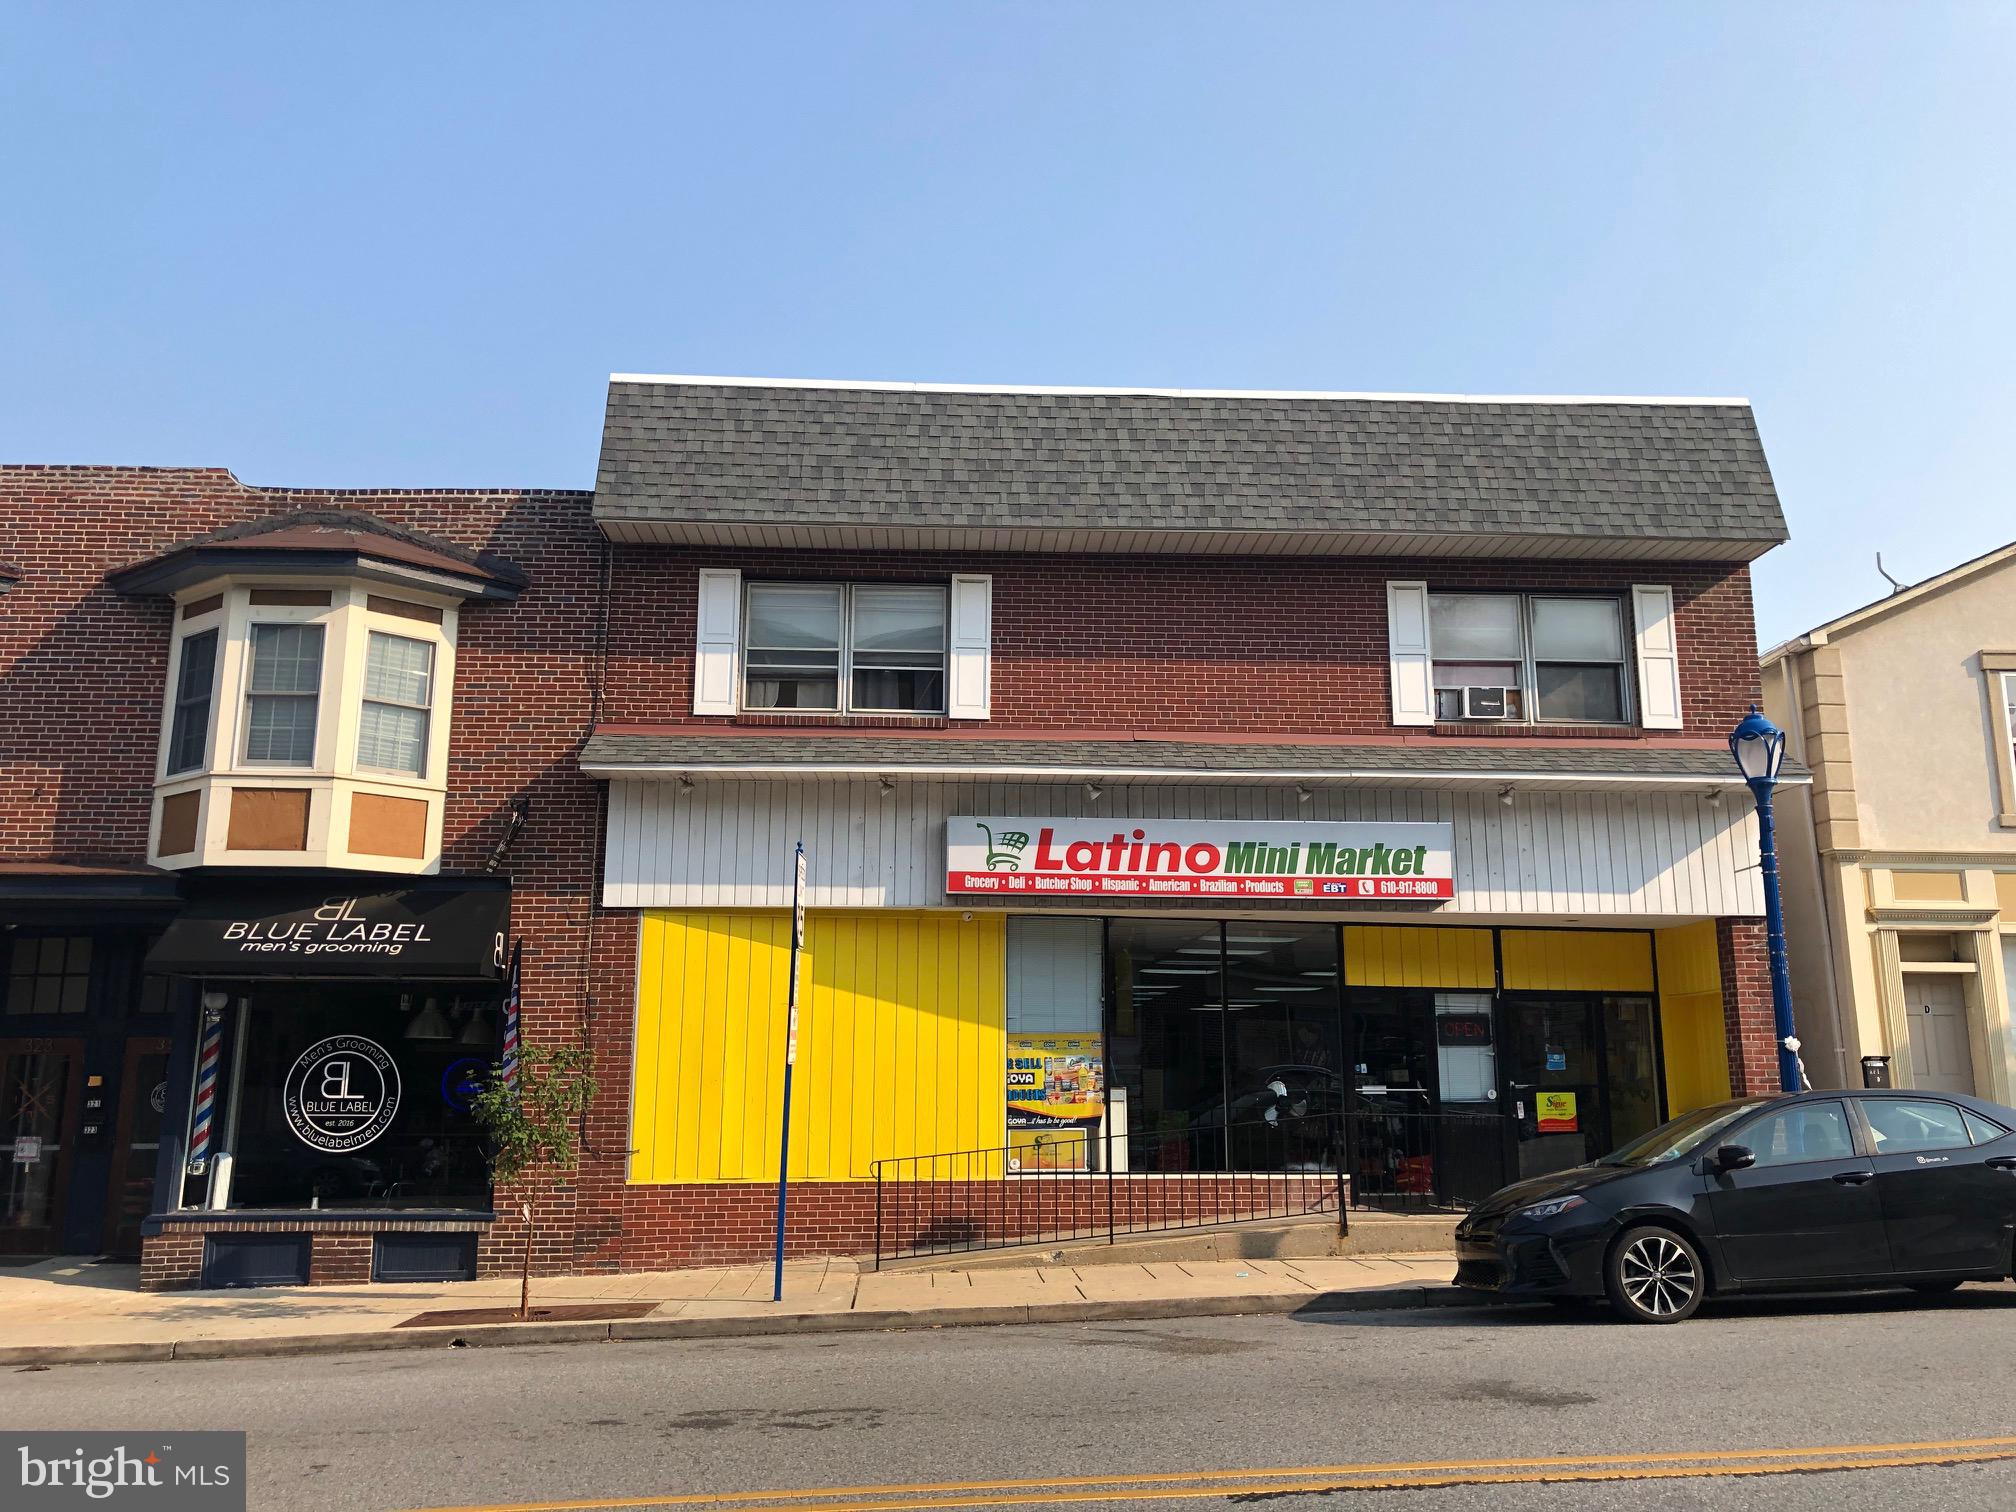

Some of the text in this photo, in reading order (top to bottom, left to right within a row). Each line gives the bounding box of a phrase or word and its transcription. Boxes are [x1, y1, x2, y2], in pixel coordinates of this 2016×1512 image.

[1034, 828, 1427, 876] Latino Mini Market
[965, 874, 1285, 894] Grocery Deli Butcher Shop Hispanic American Brazilian Products
[1323, 884, 1347, 893] EBT
[1380, 881, 1438, 895] 610-917-8800
[222, 921, 432, 942] BLUE LABEL
[239, 940, 404, 956] men's grooming
[1924, 1005, 1931, 1014] D
[1445, 1022, 1485, 1037] OPEN
[300, 1038, 390, 1070] Men's Grooming
[1015, 1057, 1043, 1070] SELL
[306, 1101, 375, 1112] BLUE LABEL
[288, 1095, 397, 1149] www.bluelabelmen.com
[337, 1119, 355, 1127] 2016
[1007, 1117, 1027, 1125] GOYA
